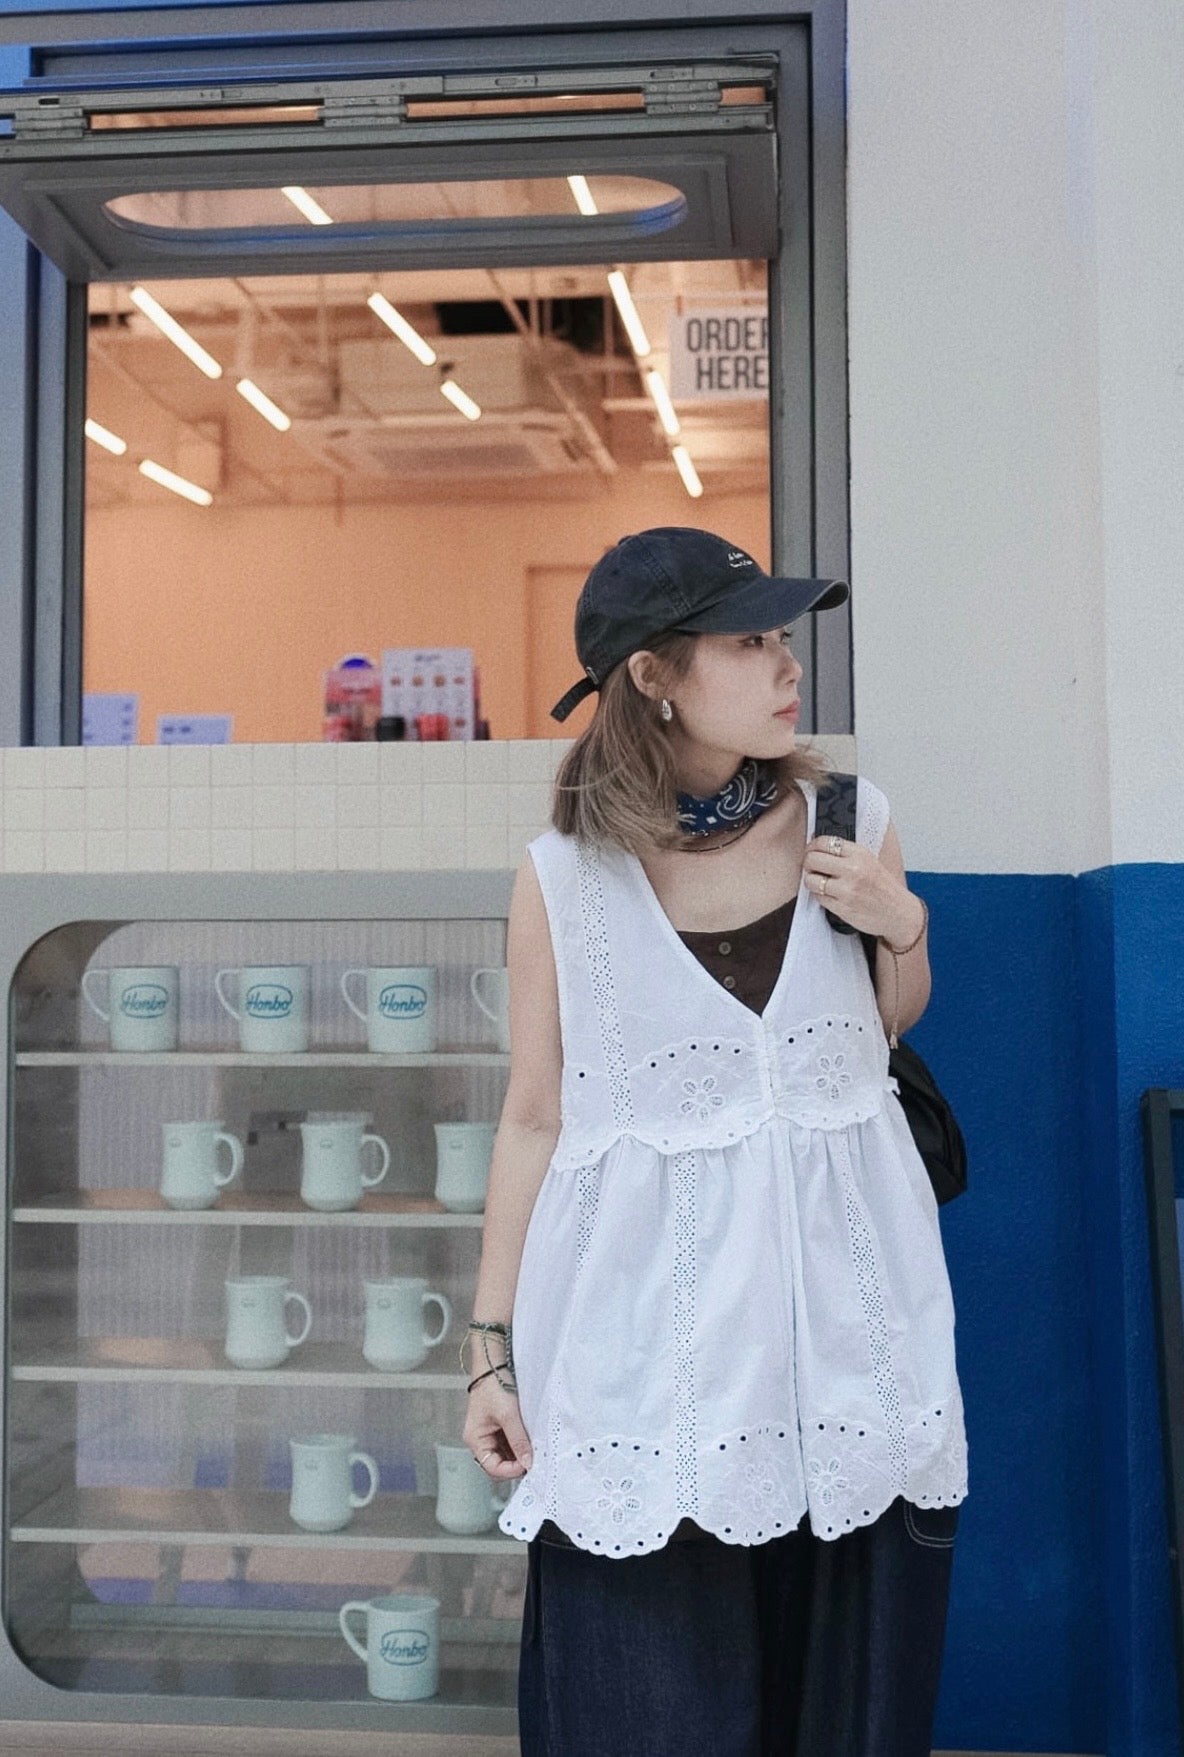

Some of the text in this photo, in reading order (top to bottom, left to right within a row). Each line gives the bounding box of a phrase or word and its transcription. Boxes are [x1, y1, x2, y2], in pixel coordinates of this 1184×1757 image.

[696, 355, 769, 390] HERE
[379, 992, 426, 1011] Honbo
[380, 1638, 428, 1657] Honbo
